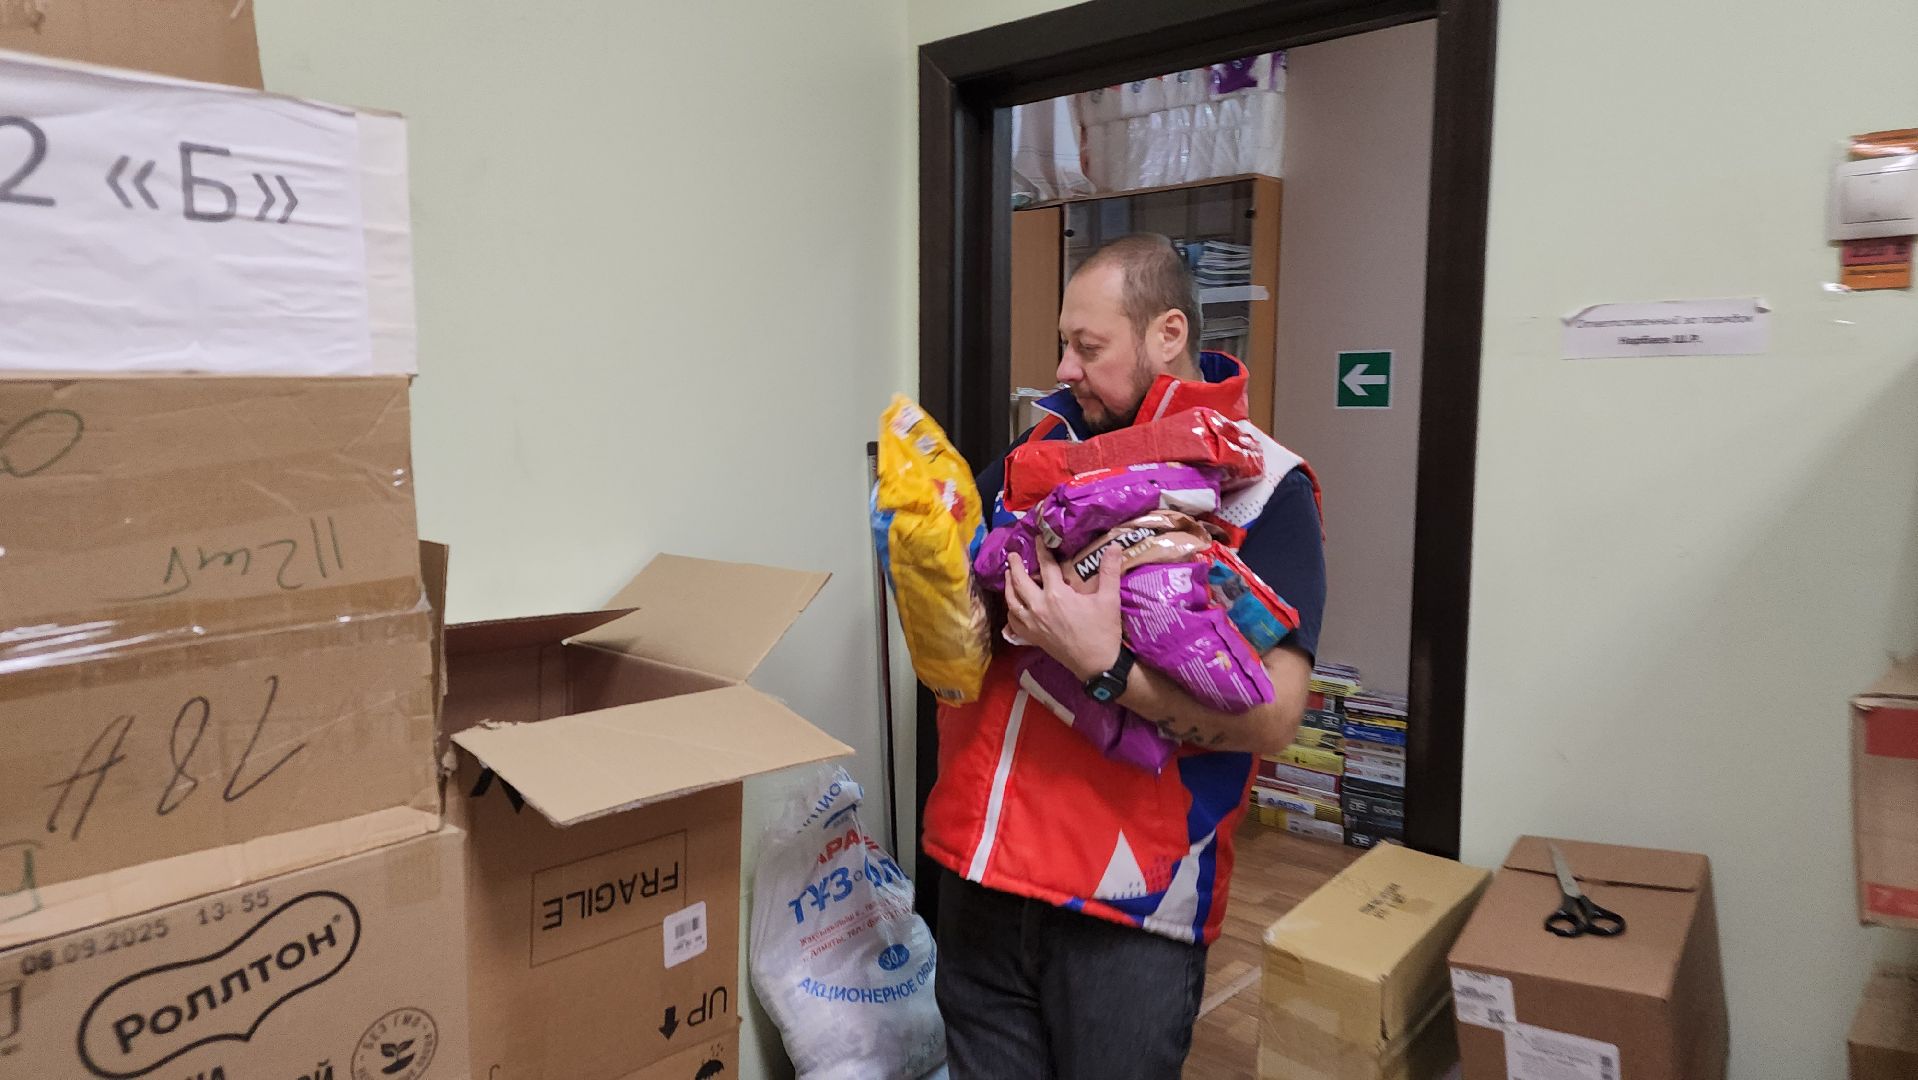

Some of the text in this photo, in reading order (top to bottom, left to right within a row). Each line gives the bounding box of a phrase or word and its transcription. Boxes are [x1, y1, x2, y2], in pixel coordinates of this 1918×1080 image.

[105, 141, 299, 224] «Б»
[1076, 527, 1156, 577] МИТОР
[542, 861, 680, 931] FRAGILE
[687, 986, 728, 1027] UP
[798, 977, 919, 1004] АКЦИОНЕРНОЕ
